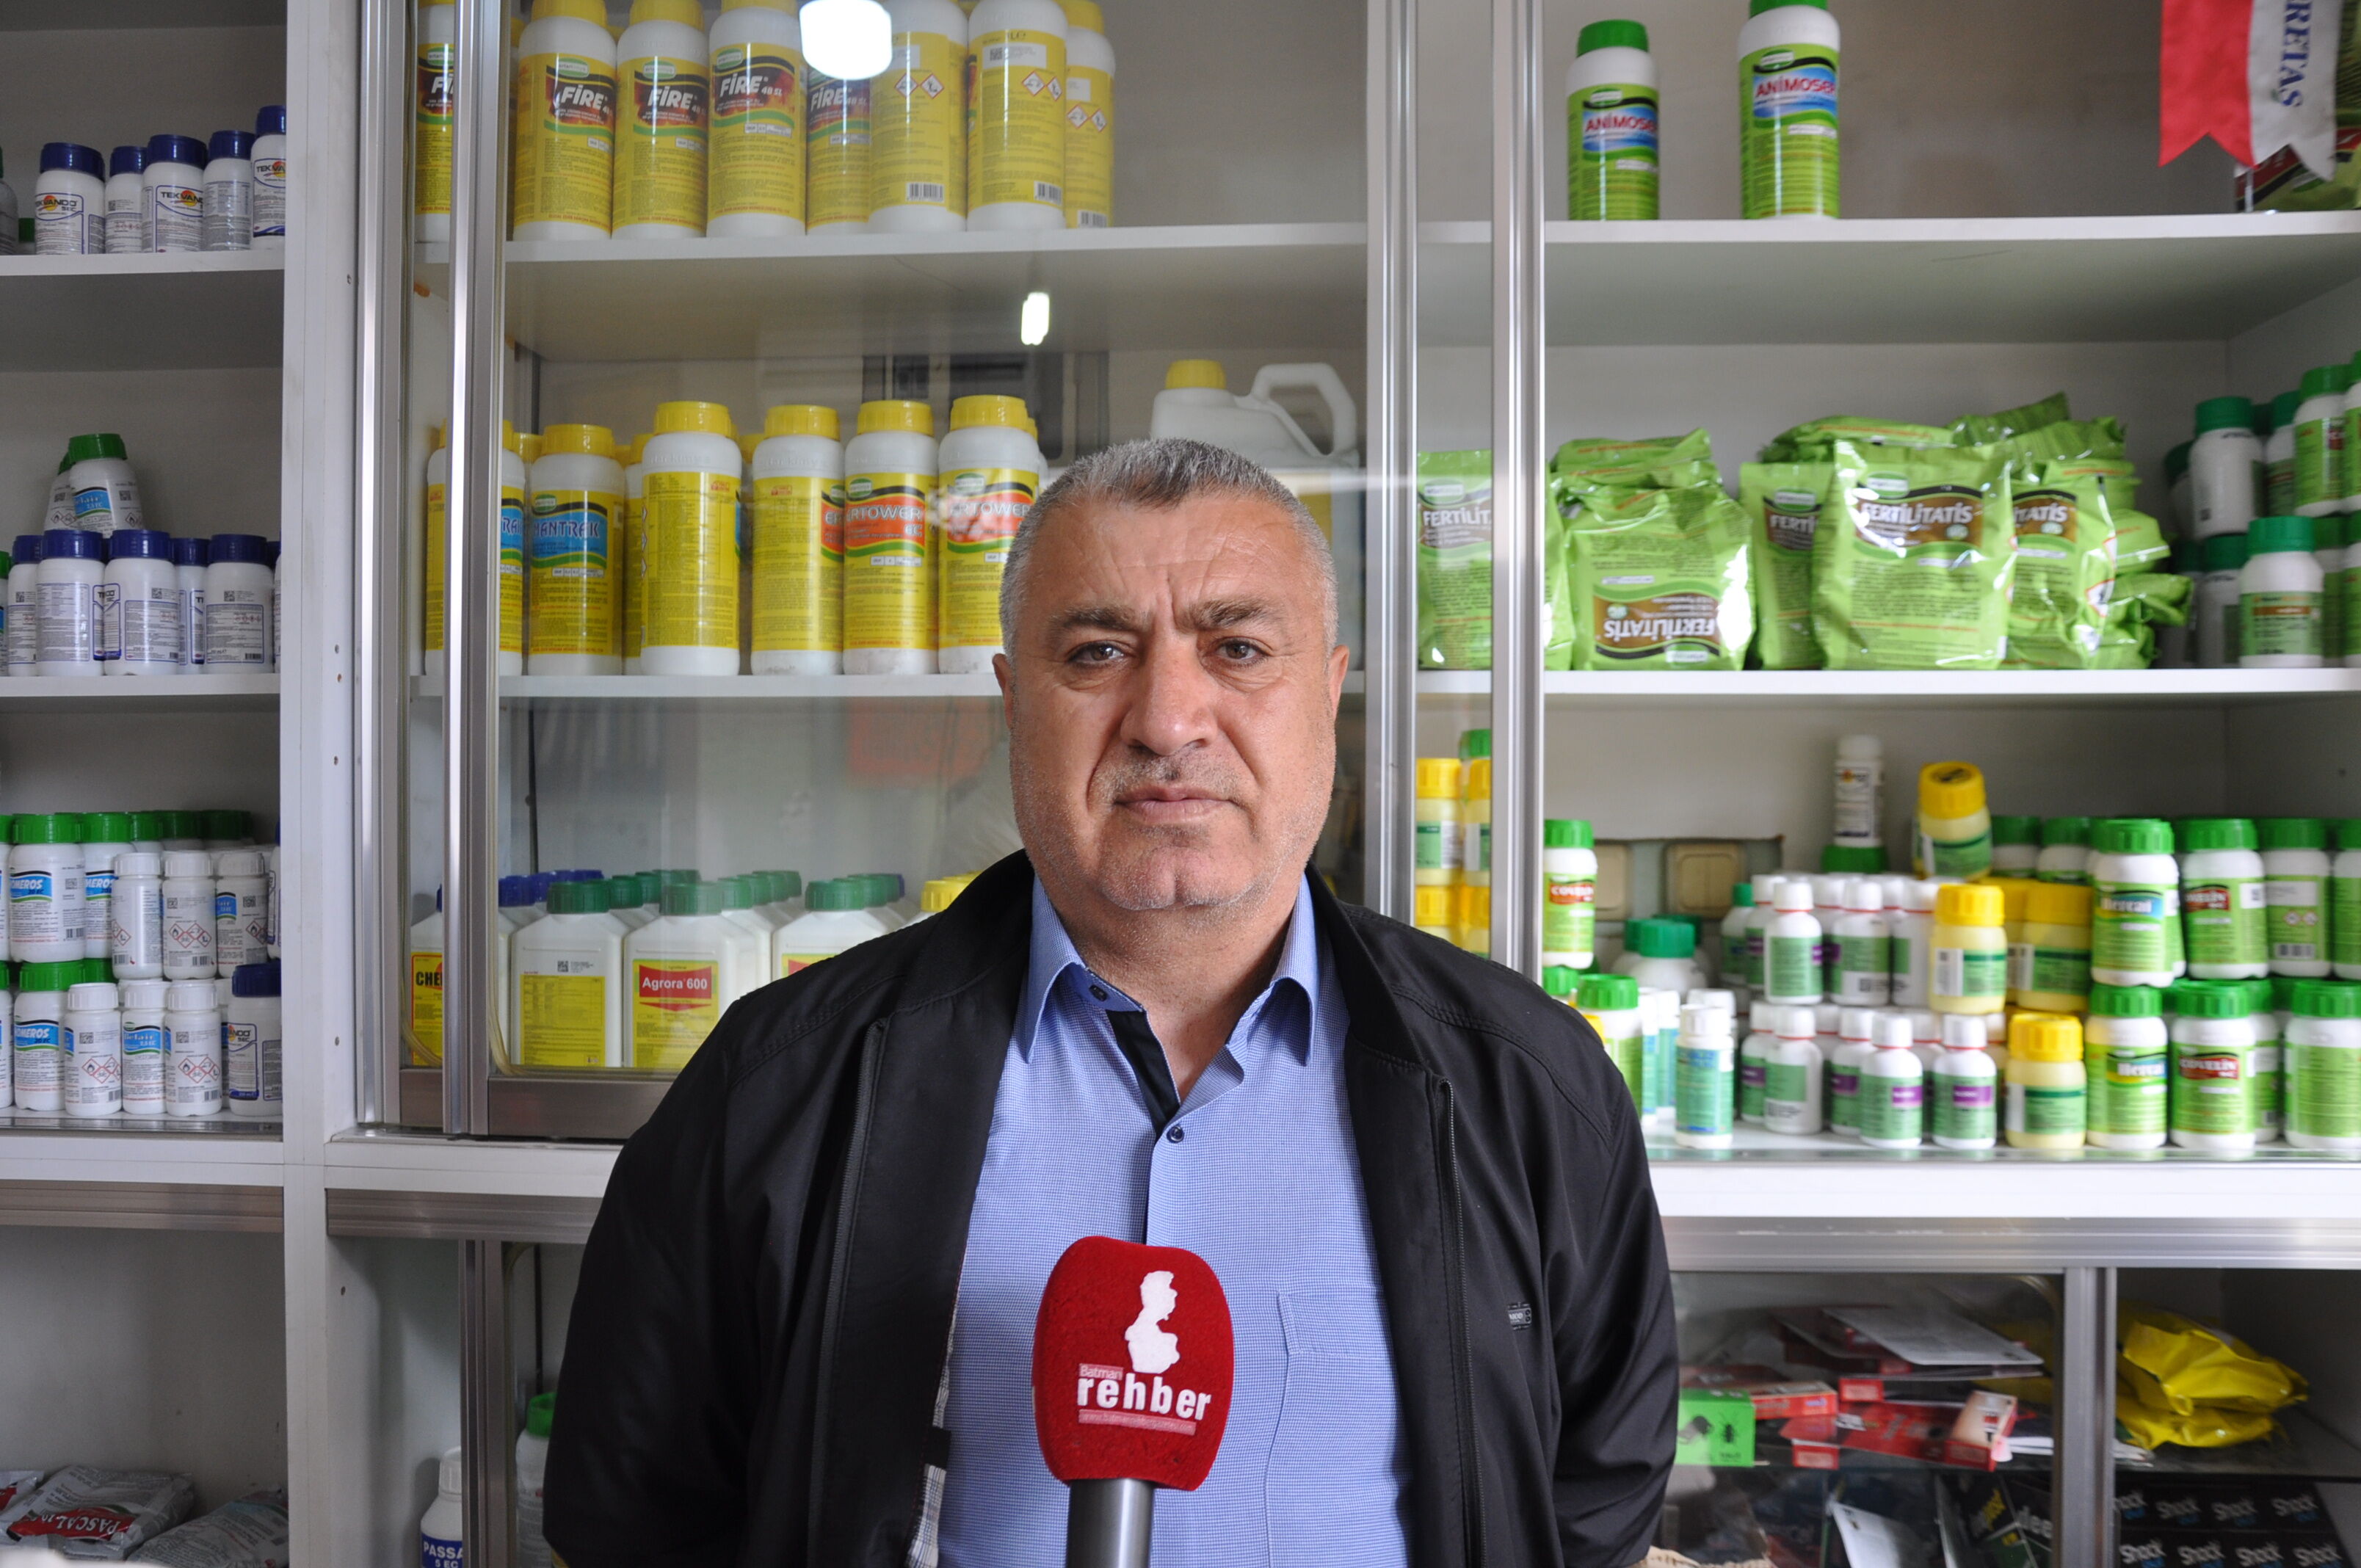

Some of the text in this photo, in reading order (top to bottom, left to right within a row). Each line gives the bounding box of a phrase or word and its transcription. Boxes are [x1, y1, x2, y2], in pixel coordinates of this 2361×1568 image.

[2278, 0, 2311, 107] RETAS
[719, 73, 763, 97] FİRE
[561, 84, 605, 109] FİRE
[647, 86, 693, 111] FİRE
[810, 87, 845, 111] FİRE
[257, 165, 286, 173] TEKVA
[161, 191, 203, 203] TEKVAN
[1423, 506, 1491, 526] FERTİLİT
[1769, 513, 1816, 534] FERTİ
[642, 977, 708, 991] Agrora 600
[1080, 1365, 1122, 1380] Batman
[1077, 1372, 1211, 1421] rehber
[57, 1517, 121, 1533] PASCAL
[443, 1560, 459, 1568] EC
